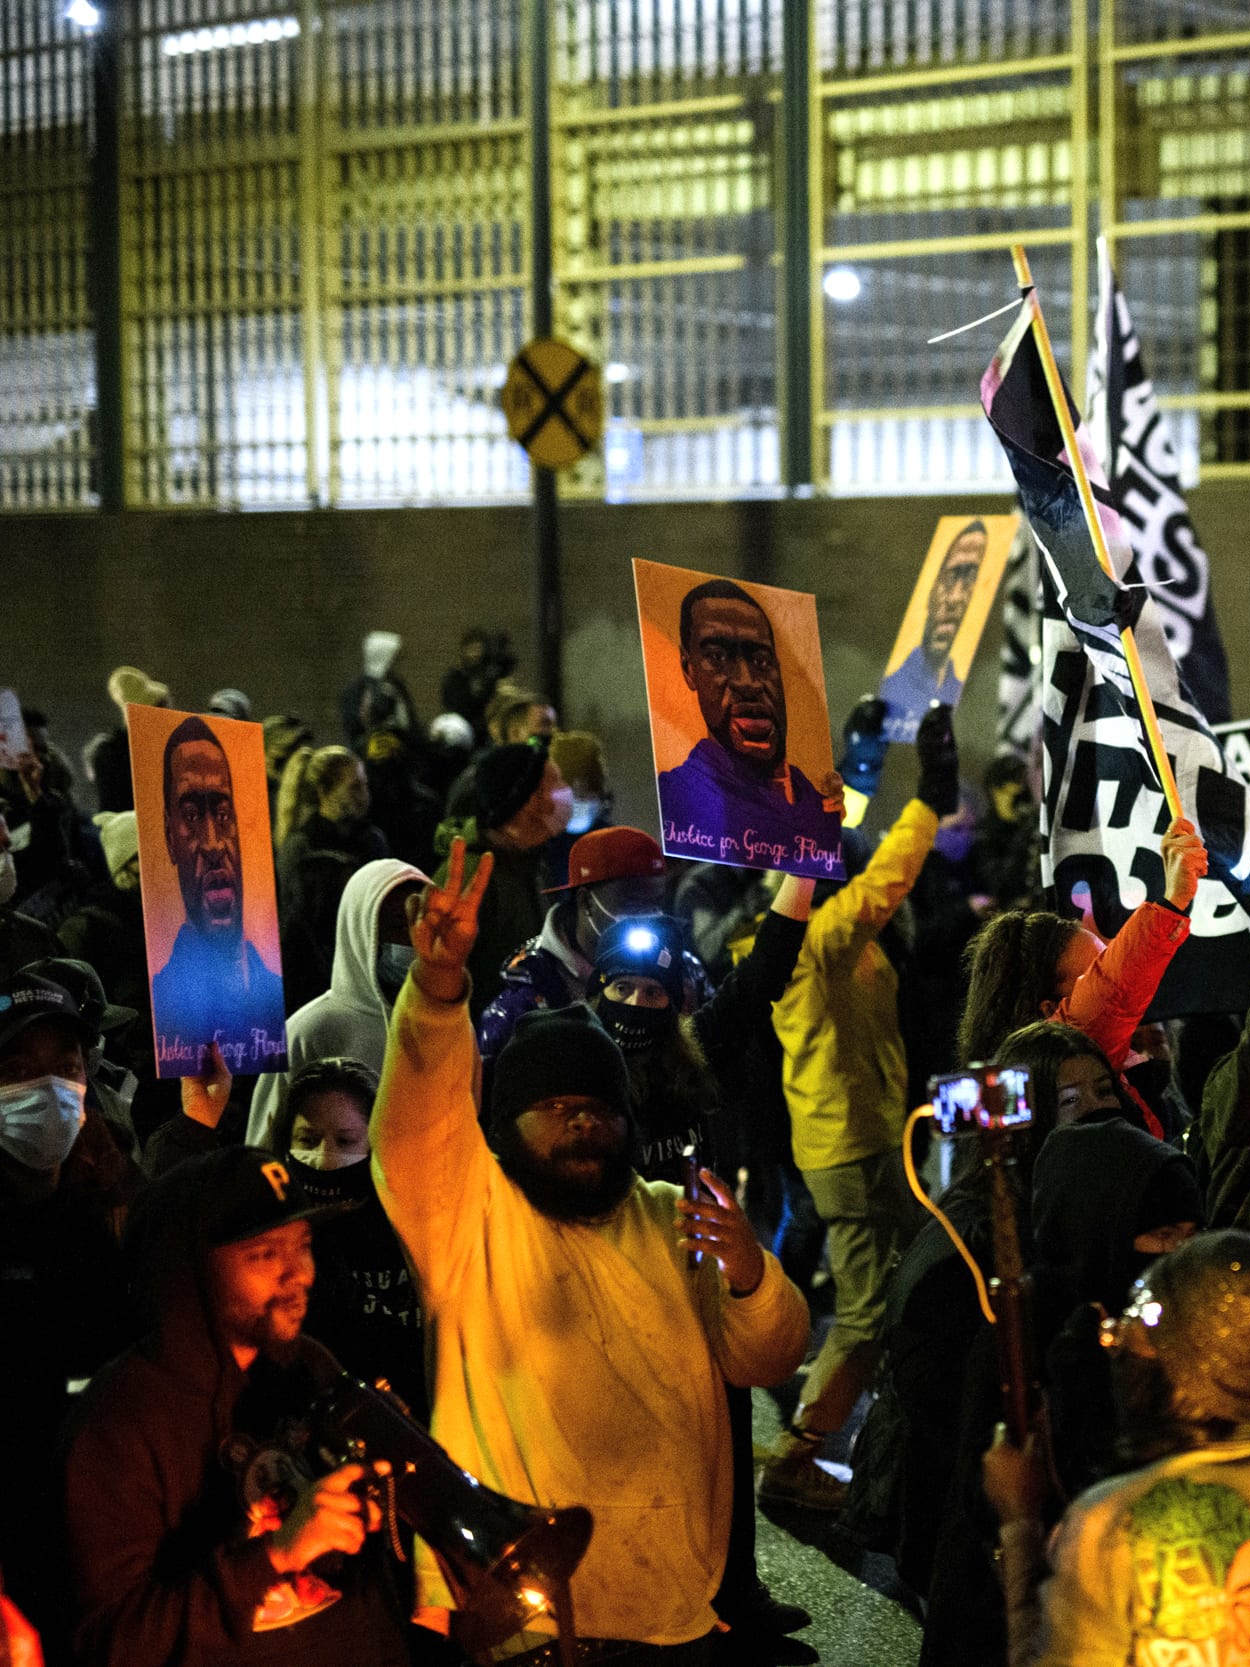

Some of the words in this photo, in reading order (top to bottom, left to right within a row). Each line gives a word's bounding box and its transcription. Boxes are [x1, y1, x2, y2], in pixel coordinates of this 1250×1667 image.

[664, 820, 716, 848] Justice
[719, 836, 741, 859] for
[743, 828, 789, 866] George
[793, 834, 843, 873] Floyd
